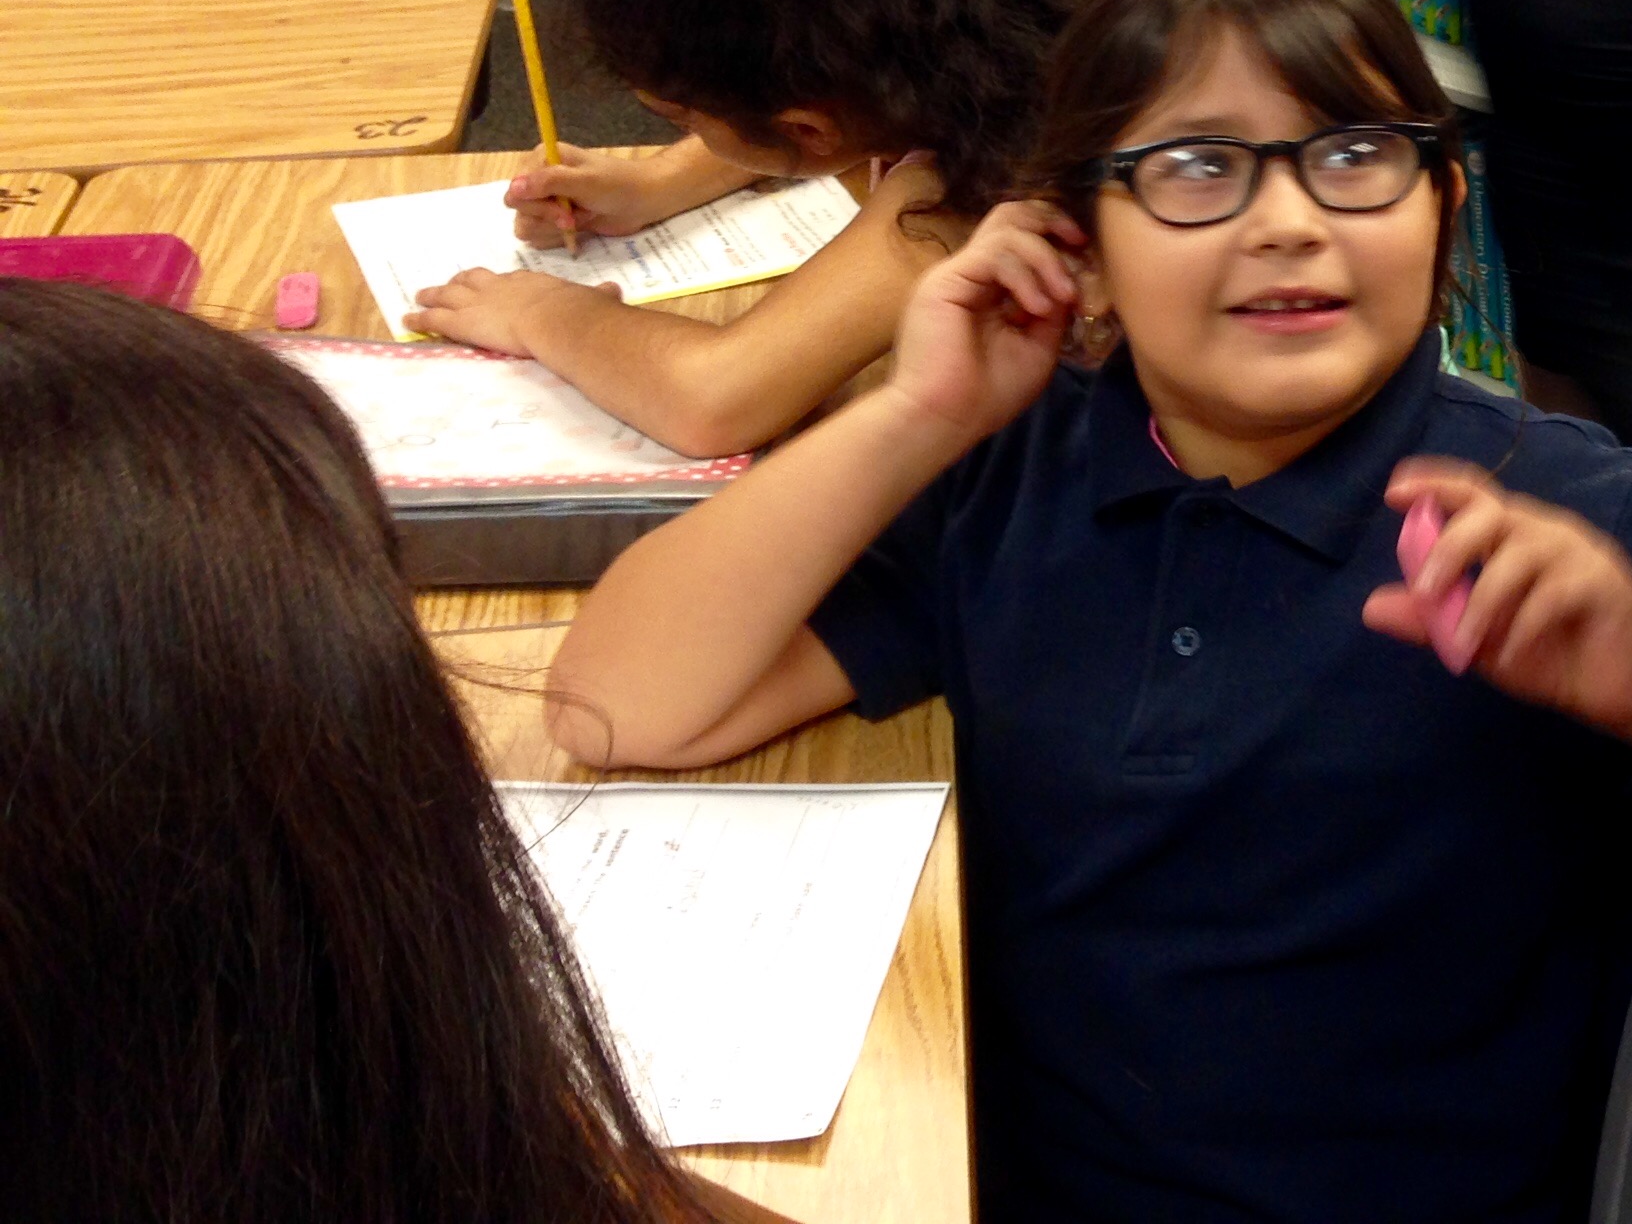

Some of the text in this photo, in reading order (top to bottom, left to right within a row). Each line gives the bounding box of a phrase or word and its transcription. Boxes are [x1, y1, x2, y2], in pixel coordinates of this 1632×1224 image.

[353, 115, 428, 141] 23
[1473, 180, 1486, 258] Elementary
[604, 827, 630, 867] sentence
